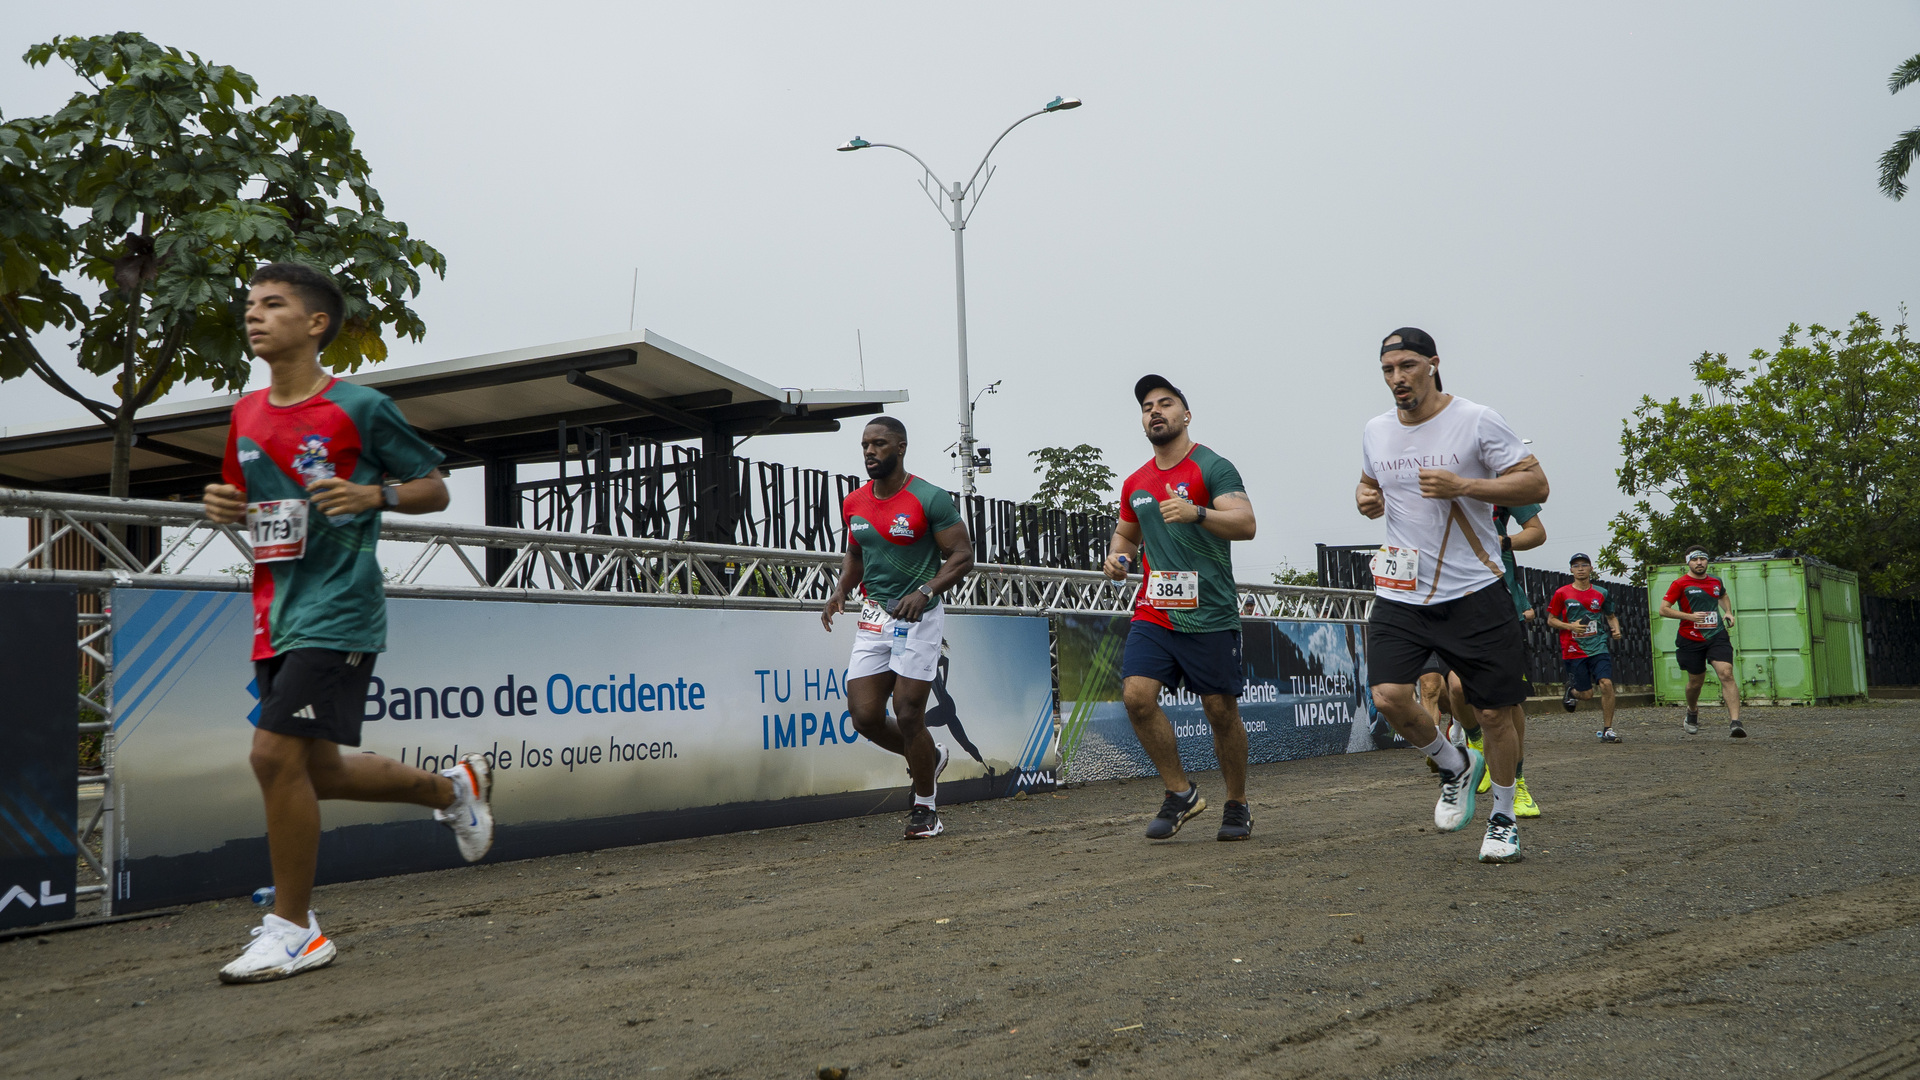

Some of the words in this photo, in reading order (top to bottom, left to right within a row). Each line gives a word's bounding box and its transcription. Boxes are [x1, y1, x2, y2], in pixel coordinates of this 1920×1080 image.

[1372, 453, 1460, 473] CAMPANELLA
[1395, 472, 1419, 480] PLAZ
[1385, 559, 1398, 576] 79
[1156, 582, 1184, 597] 384
[862, 608, 882, 623] 641
[754, 669, 791, 703] TU
[1289, 674, 1306, 698] TU
[1309, 674, 1351, 698] HACER,
[361, 675, 485, 722] Banco
[494, 674, 537, 717] de
[546, 673, 706, 715] Occidente
[1294, 701, 1353, 727] IMPACTA.
[762, 710, 859, 750] IMPAC
[1174, 719, 1195, 738] lado
[1196, 718, 1208, 736] de
[416, 744, 459, 775] lad
[520, 740, 553, 768] los
[561, 745, 602, 772] que
[609, 736, 679, 762] hacen.
[1017, 771, 1054, 786] AVAL
